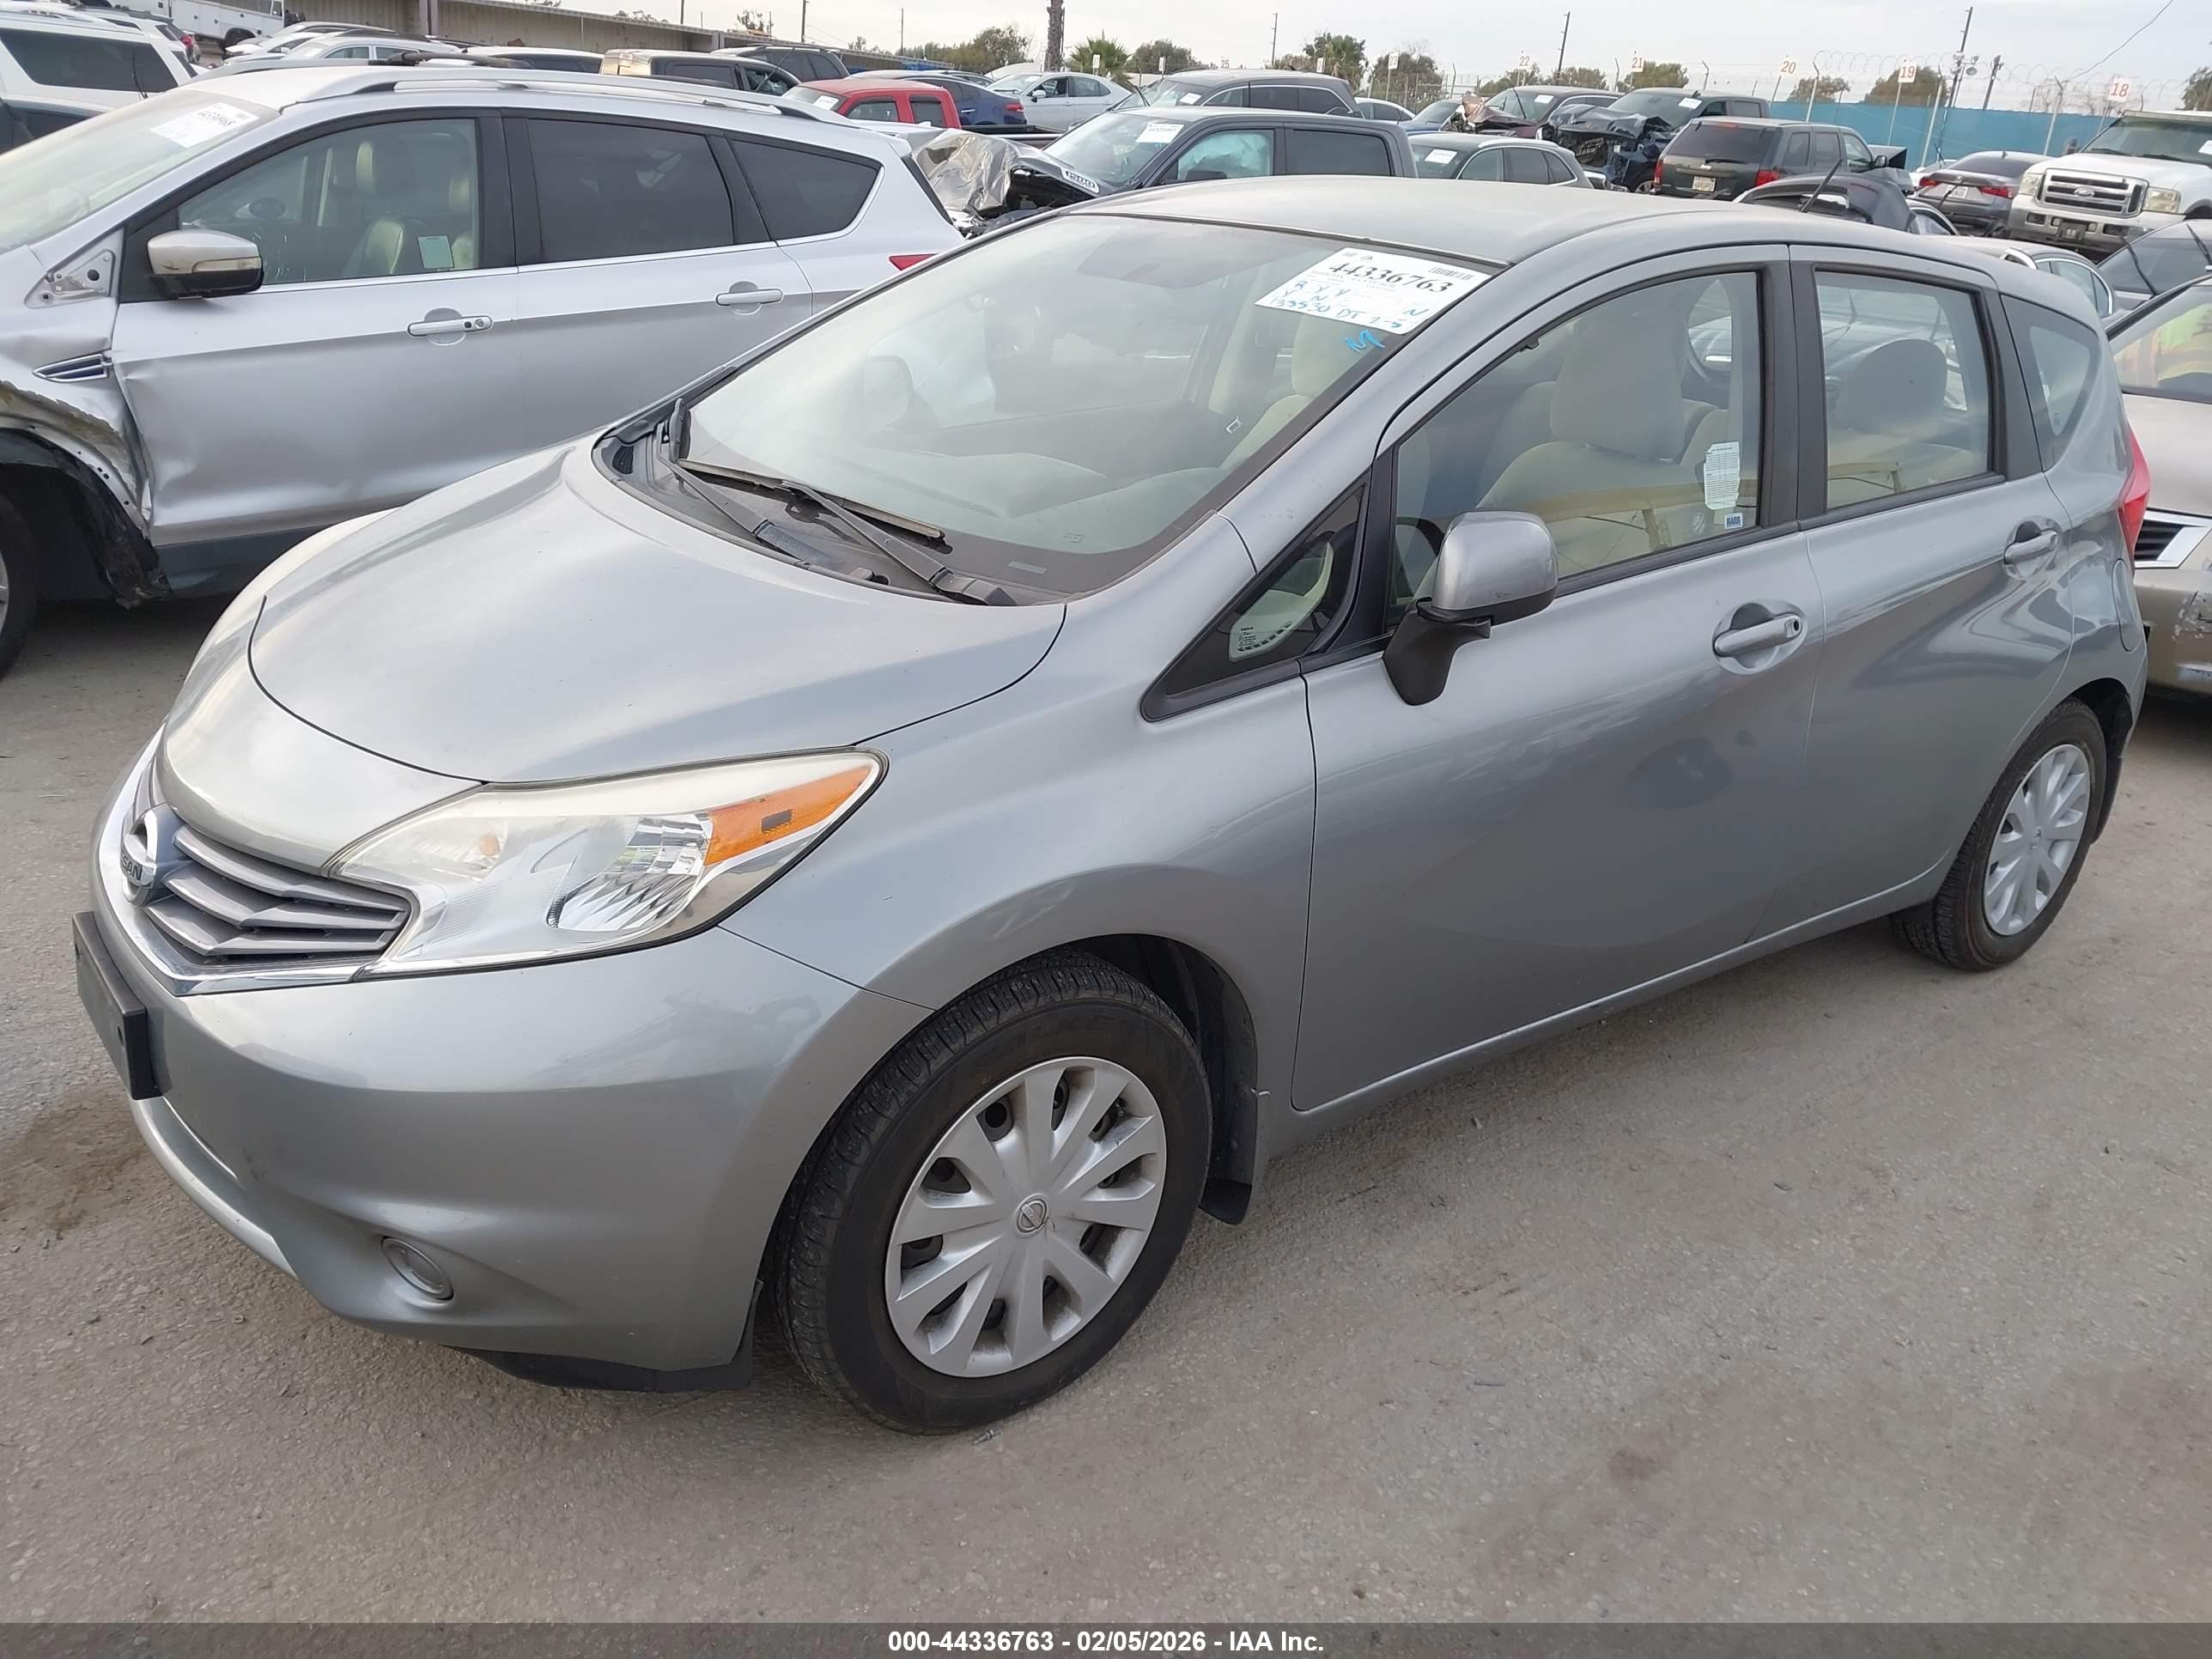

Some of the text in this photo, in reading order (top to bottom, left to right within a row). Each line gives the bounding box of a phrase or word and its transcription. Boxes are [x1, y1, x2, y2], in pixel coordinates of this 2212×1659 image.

[1220, 59, 1230, 69] 25
[1519, 56, 1530, 67] 22
[1632, 57, 1643, 69] 21
[1780, 60, 1796, 74] 20
[1899, 65, 1916, 78] 19
[2110, 82, 2130, 98] 18
[1328, 262, 1454, 293] 44336763
